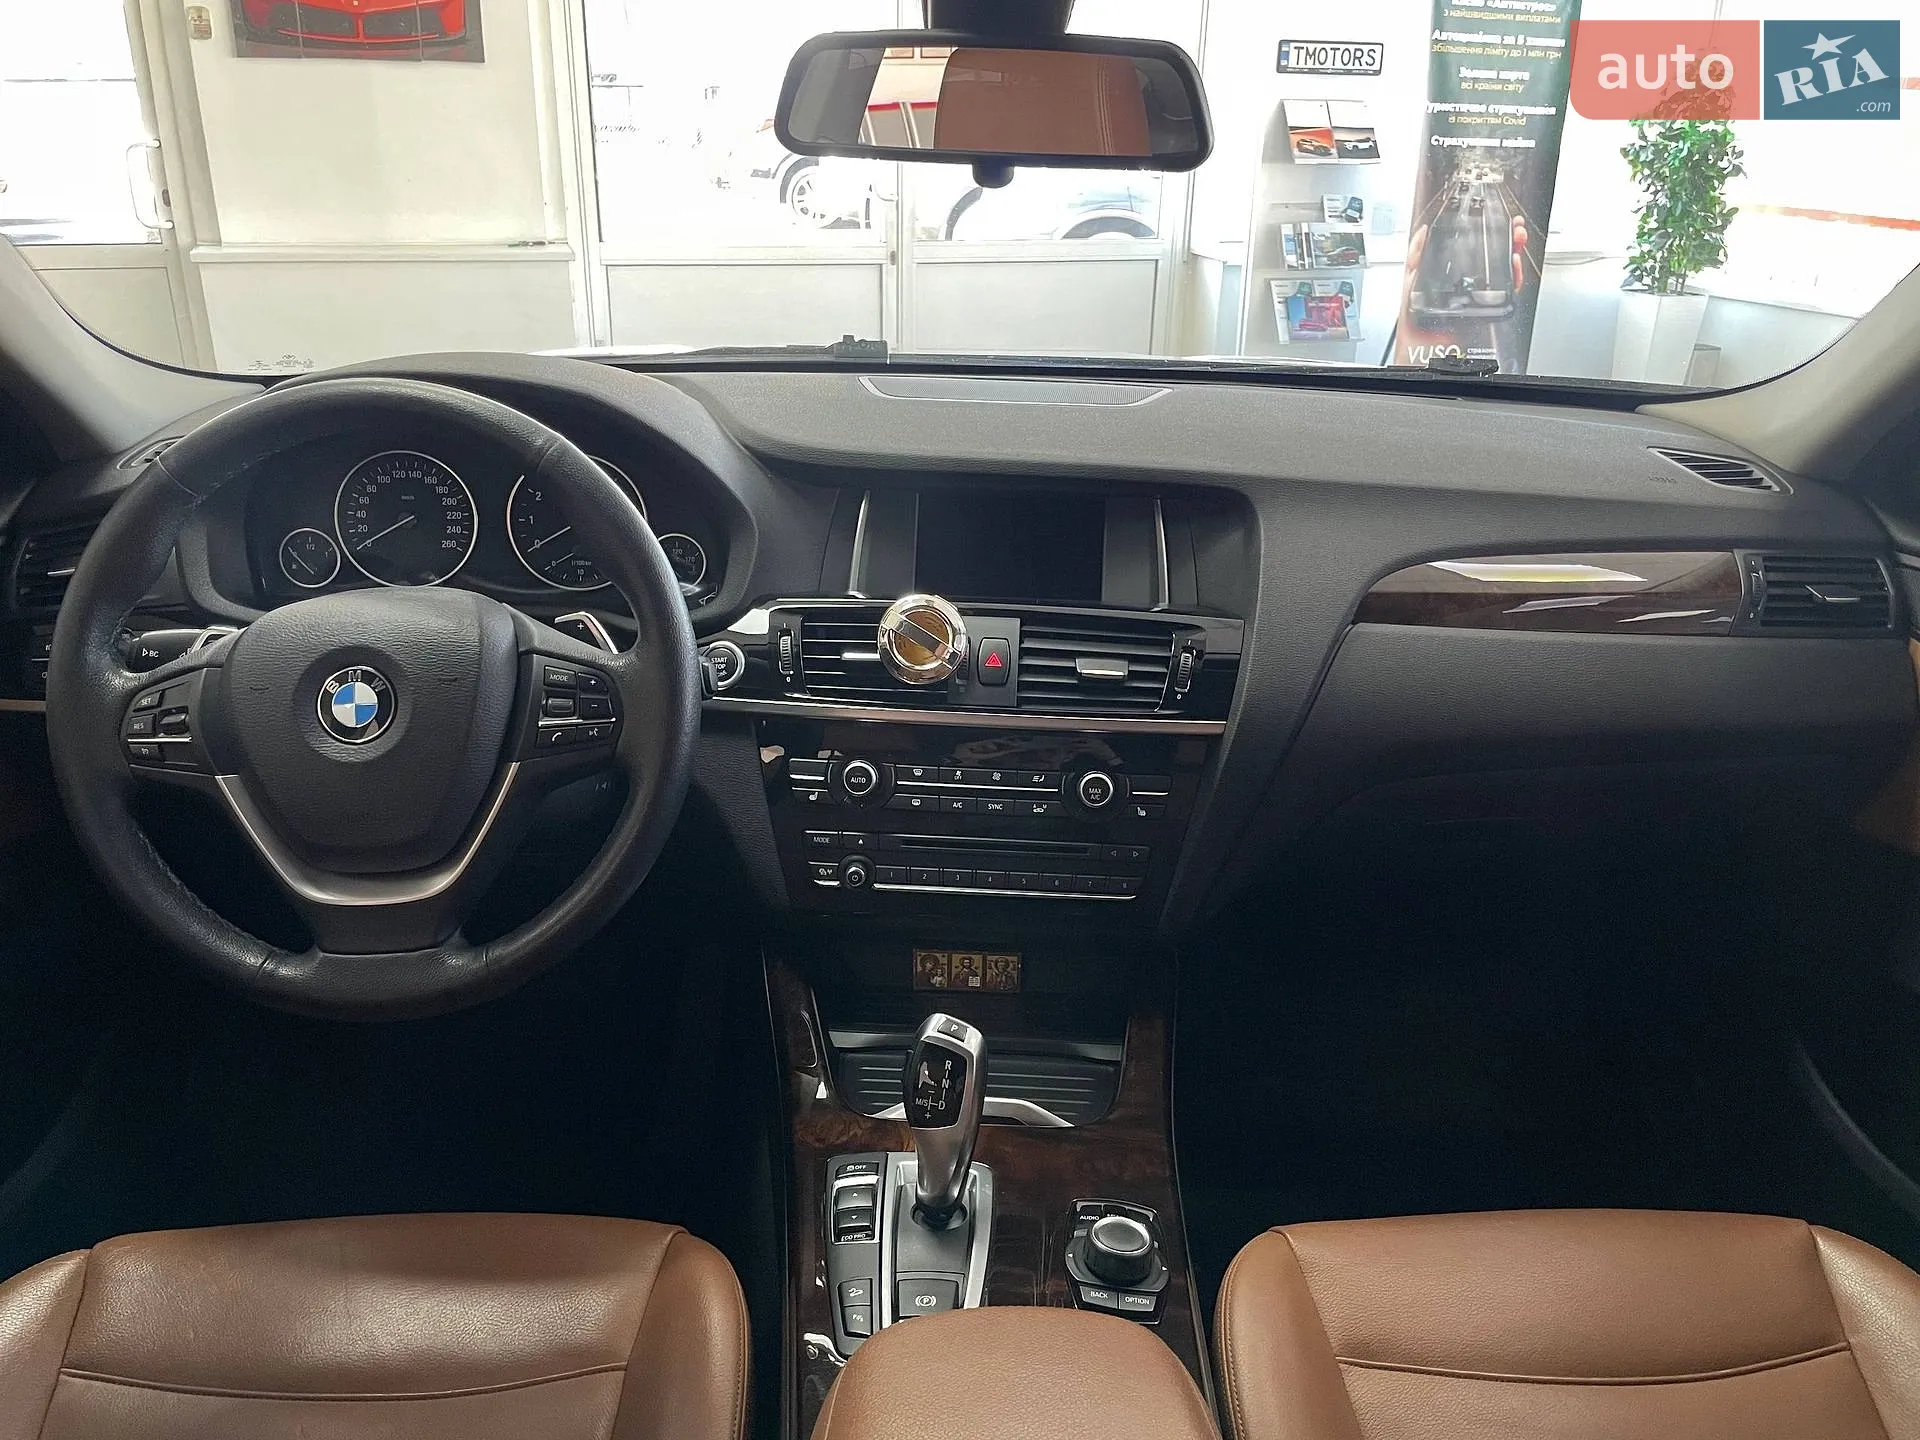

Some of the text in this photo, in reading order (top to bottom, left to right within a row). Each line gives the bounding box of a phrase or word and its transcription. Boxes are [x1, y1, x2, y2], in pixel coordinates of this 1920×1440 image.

[1431, 42, 1483, 55] збільшення
[1484, 46, 1509, 58] ліміту
[1510, 49, 1522, 57] до
[1528, 50, 1544, 58] млн
[1293, 46, 1376, 67] TMOTORS
[1503, 83, 1524, 93] світу
[1457, 116, 1502, 126] покриттям
[1503, 115, 1527, 126] Covid
[392, 470, 405, 478] 120
[408, 470, 422, 478] 140
[377, 475, 391, 483] 100
[424, 476, 438, 484] 160
[366, 485, 377, 493] 80
[435, 486, 449, 494] 180
[359, 496, 370, 504] 60
[535, 491, 542, 501] 2
[442, 497, 458, 506] 200
[355, 510, 367, 518] 40
[446, 511, 462, 519] 220
[529, 515, 534, 524] 1
[357, 524, 368, 533] 20
[446, 525, 462, 534] 240
[441, 540, 457, 548] 260
[149, 650, 159, 658] BC
[711, 656, 727, 664] START
[326, 670, 386, 694] BMW
[549, 674, 568, 682] MODE
[141, 698, 151, 706] SET
[850, 776, 866, 784] AUTO
[987, 803, 1004, 811] SYNC
[813, 836, 831, 844] MODE
[950, 1024, 959, 1032] P
[945, 1060, 952, 1070] R
[941, 1079, 950, 1089] N
[915, 1097, 928, 1107] M/S
[938, 1100, 946, 1110] D
[841, 1234, 853, 1242] ECO
[1090, 1290, 1108, 1299] BACK
[1125, 1296, 1150, 1305] OPTION
